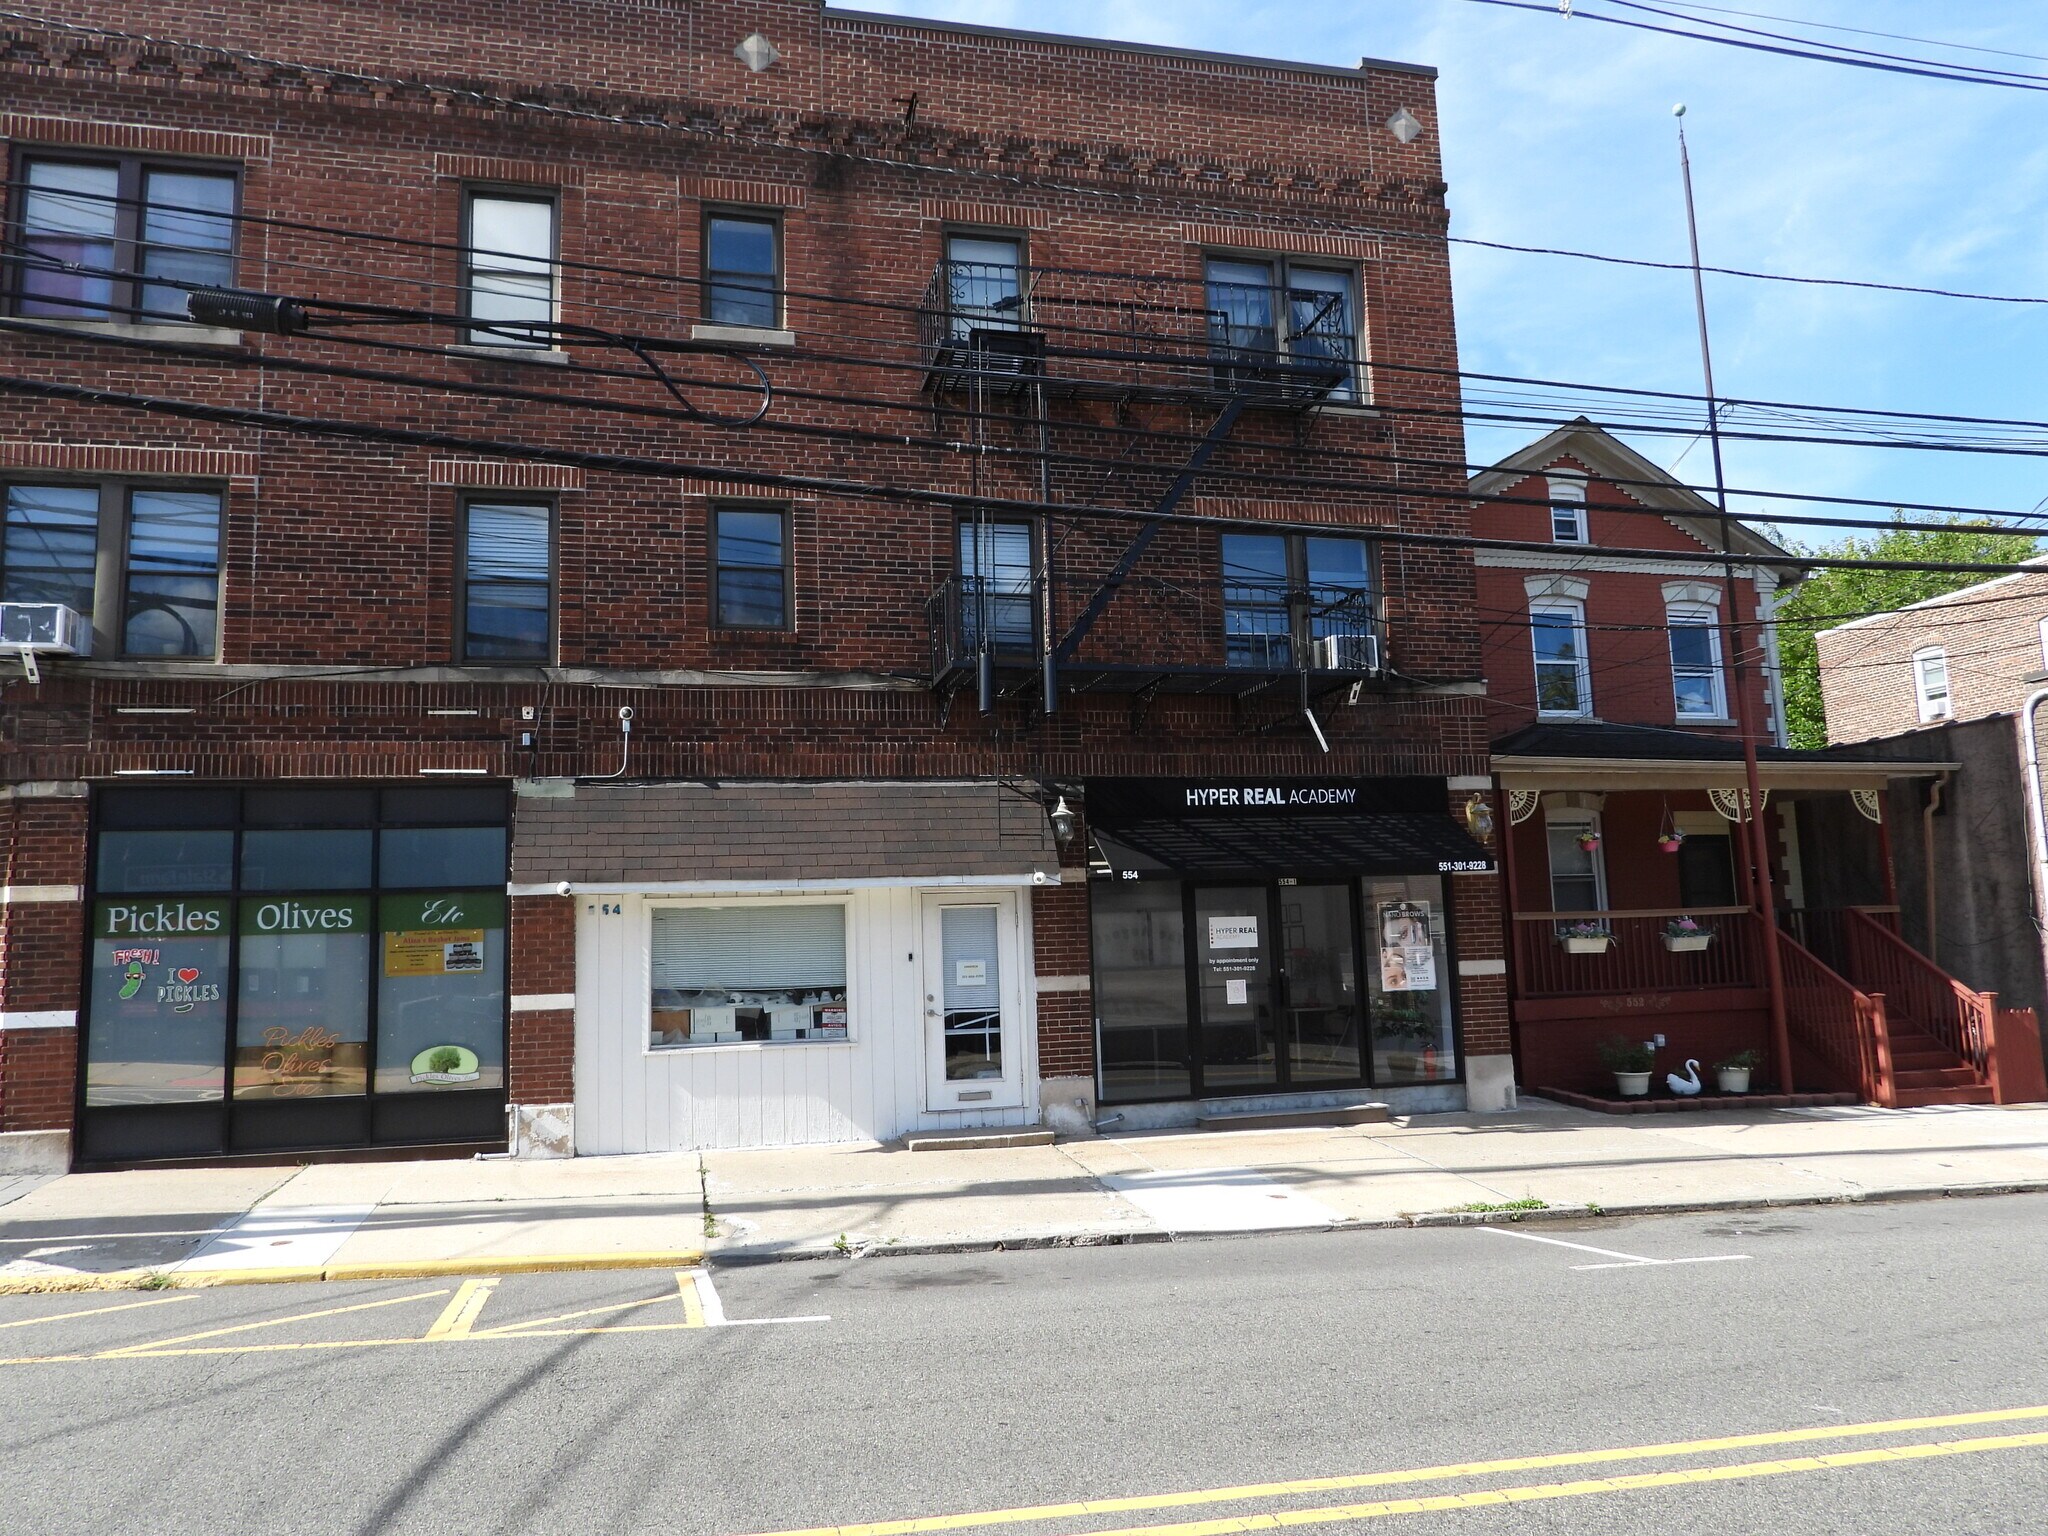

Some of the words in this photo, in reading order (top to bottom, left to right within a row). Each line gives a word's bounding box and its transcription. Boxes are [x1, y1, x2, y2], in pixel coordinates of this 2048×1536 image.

[1186, 788, 1240, 806] HYPER
[1243, 787, 1286, 805] REAL
[1289, 788, 1356, 804] ACADEMY
[1438, 860, 1487, 871] 551-301-9228
[1122, 870, 1139, 880] 554
[107, 903, 220, 933] Pickles
[256, 902, 353, 930] Olives
[421, 899, 464, 924] Etc
[1401, 910, 1425, 918] BROWS
[1215, 927, 1238, 935] HYPER
[1238, 926, 1257, 934] REAL
[1216, 957, 1248, 965] appointment
[167, 967, 176, 985] I
[157, 984, 220, 1003] PICKLES
[263, 1026, 340, 1051] Pickles
[262, 1052, 332, 1074] Olives
